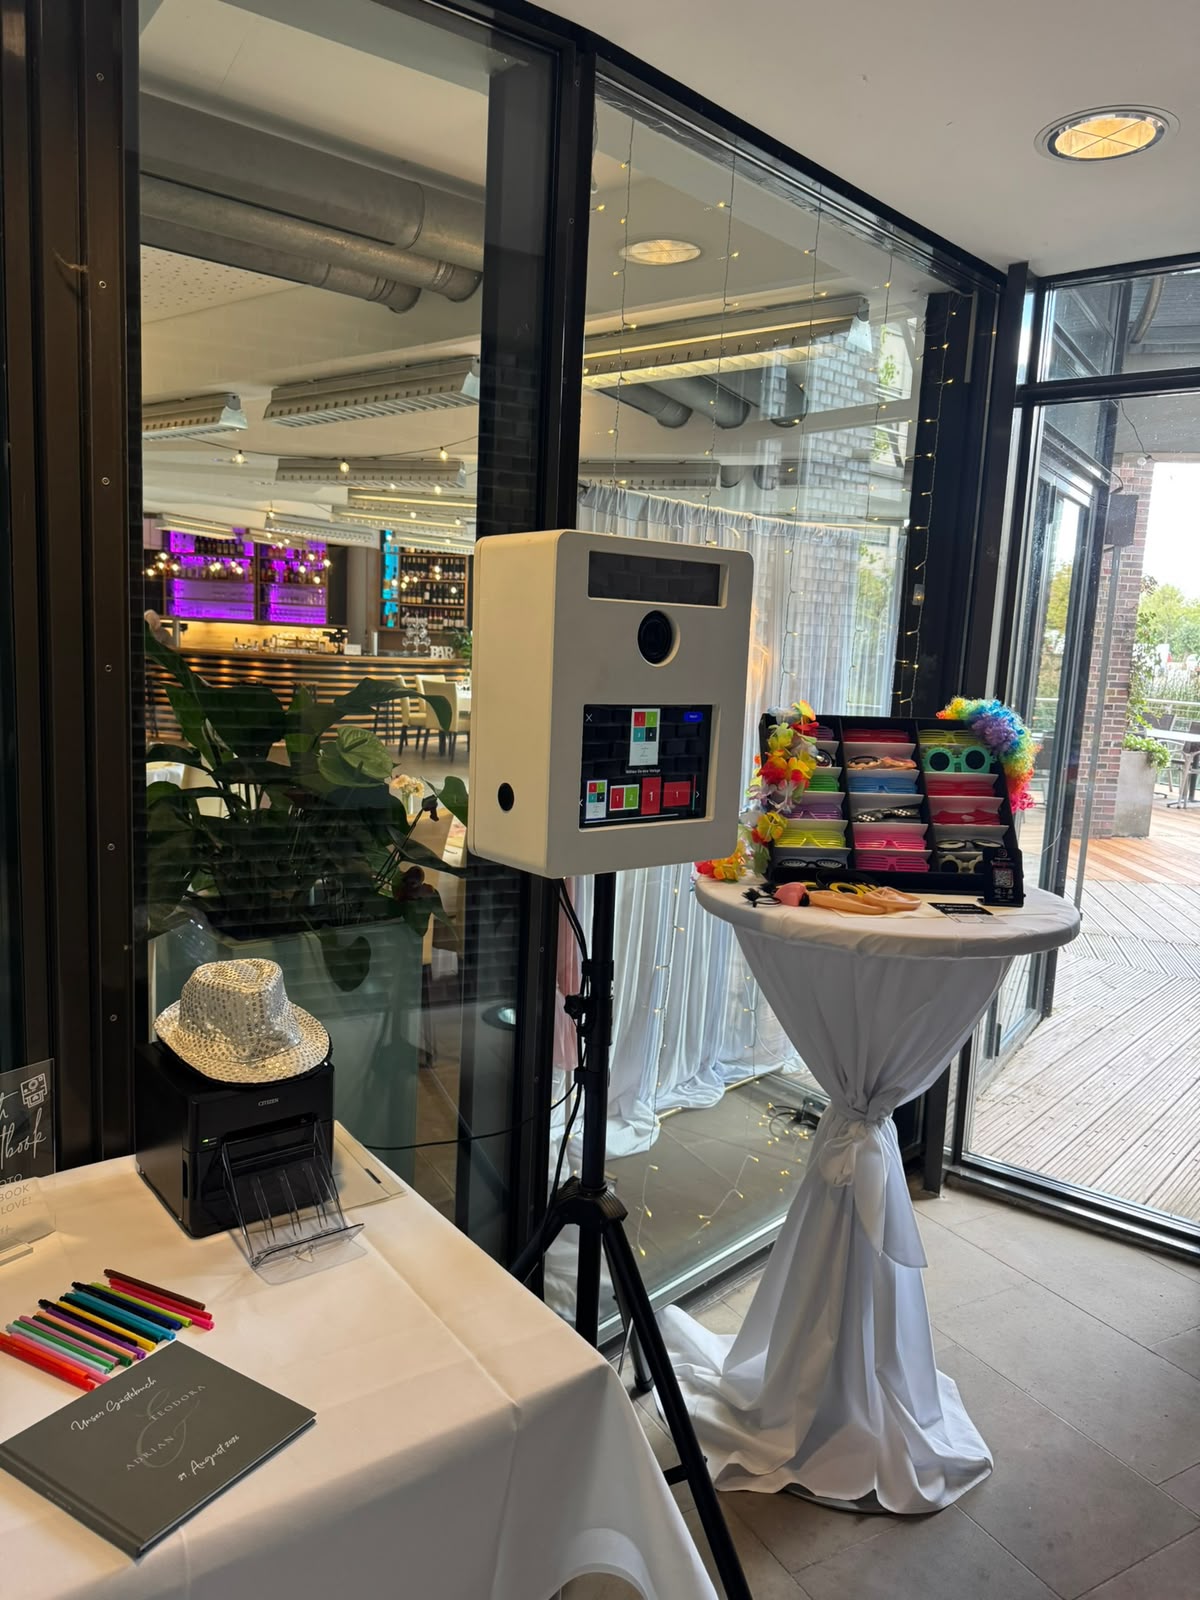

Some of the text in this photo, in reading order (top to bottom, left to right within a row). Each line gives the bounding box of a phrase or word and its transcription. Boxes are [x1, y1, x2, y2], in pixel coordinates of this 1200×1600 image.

[430, 645, 455, 659] BAR
[258, 1097, 279, 1106] CITIZEN
[1, 1196, 32, 1215] LOVE!
[151, 1385, 206, 1420] TEODORA
[70, 1411, 105, 1431] Unser
[126, 1436, 174, 1471] ADRIAN
[190, 1443, 226, 1475] August
